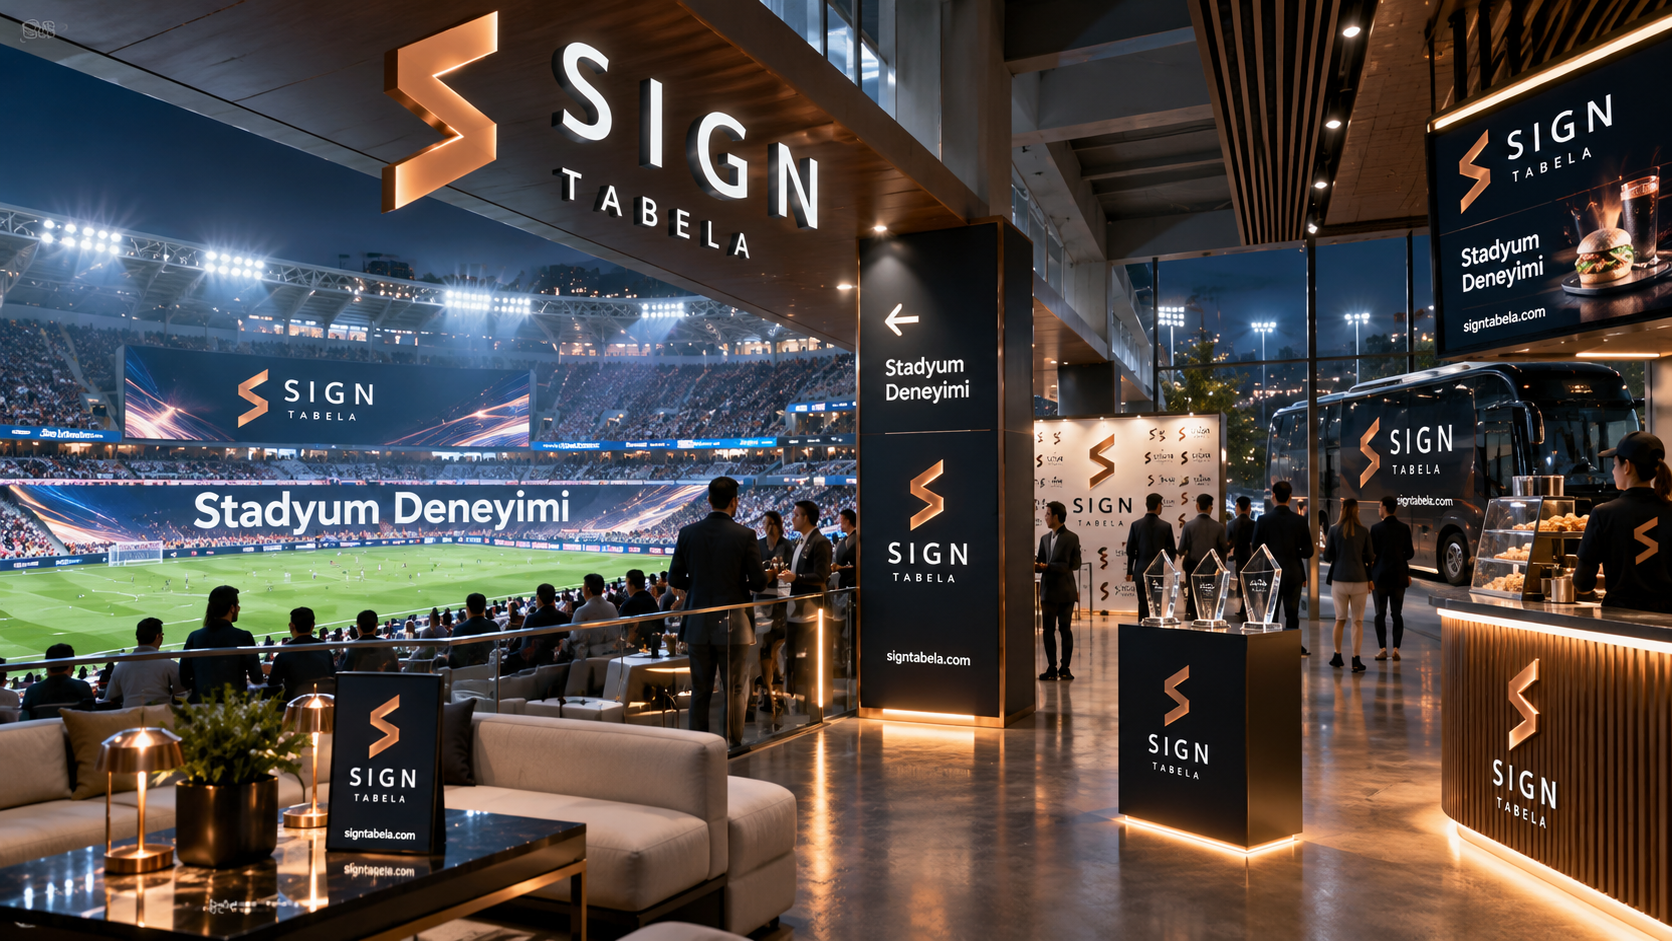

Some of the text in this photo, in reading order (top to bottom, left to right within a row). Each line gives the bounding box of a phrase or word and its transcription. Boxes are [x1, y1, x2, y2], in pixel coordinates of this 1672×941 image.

[552, 42, 818, 230] SIGN
[1507, 94, 1613, 160] SIGN
[1512, 147, 1592, 183] TABELA
[552, 167, 750, 259] TABELA
[1461, 233, 1540, 268] Stadyum
[1462, 256, 1544, 293] Deneyimi
[1463, 307, 1546, 333] signtabela.com
[885, 357, 965, 379] Stadyum
[284, 379, 374, 406] SIGN
[885, 380, 970, 405] Deneyimi
[288, 410, 357, 421] TABELA
[1390, 424, 1453, 455] SIGN
[1392, 464, 1441, 475] TABELA
[193, 489, 569, 535] Stadyum Deneyimi
[1072, 497, 1133, 514] SIGN
[1077, 519, 1124, 527] TABELA
[887, 541, 968, 566] SIGN
[892, 572, 955, 583] TABELA
[886, 650, 971, 666] signtabela.com
[1148, 733, 1209, 765] SIGN
[349, 767, 416, 788] SIGN
[1152, 761, 1199, 780] TABELA
[1492, 758, 1557, 810] SIGN
[354, 793, 406, 804] TABELA
[1496, 796, 1547, 829] TABELA
[344, 828, 416, 840] signtabela.com
